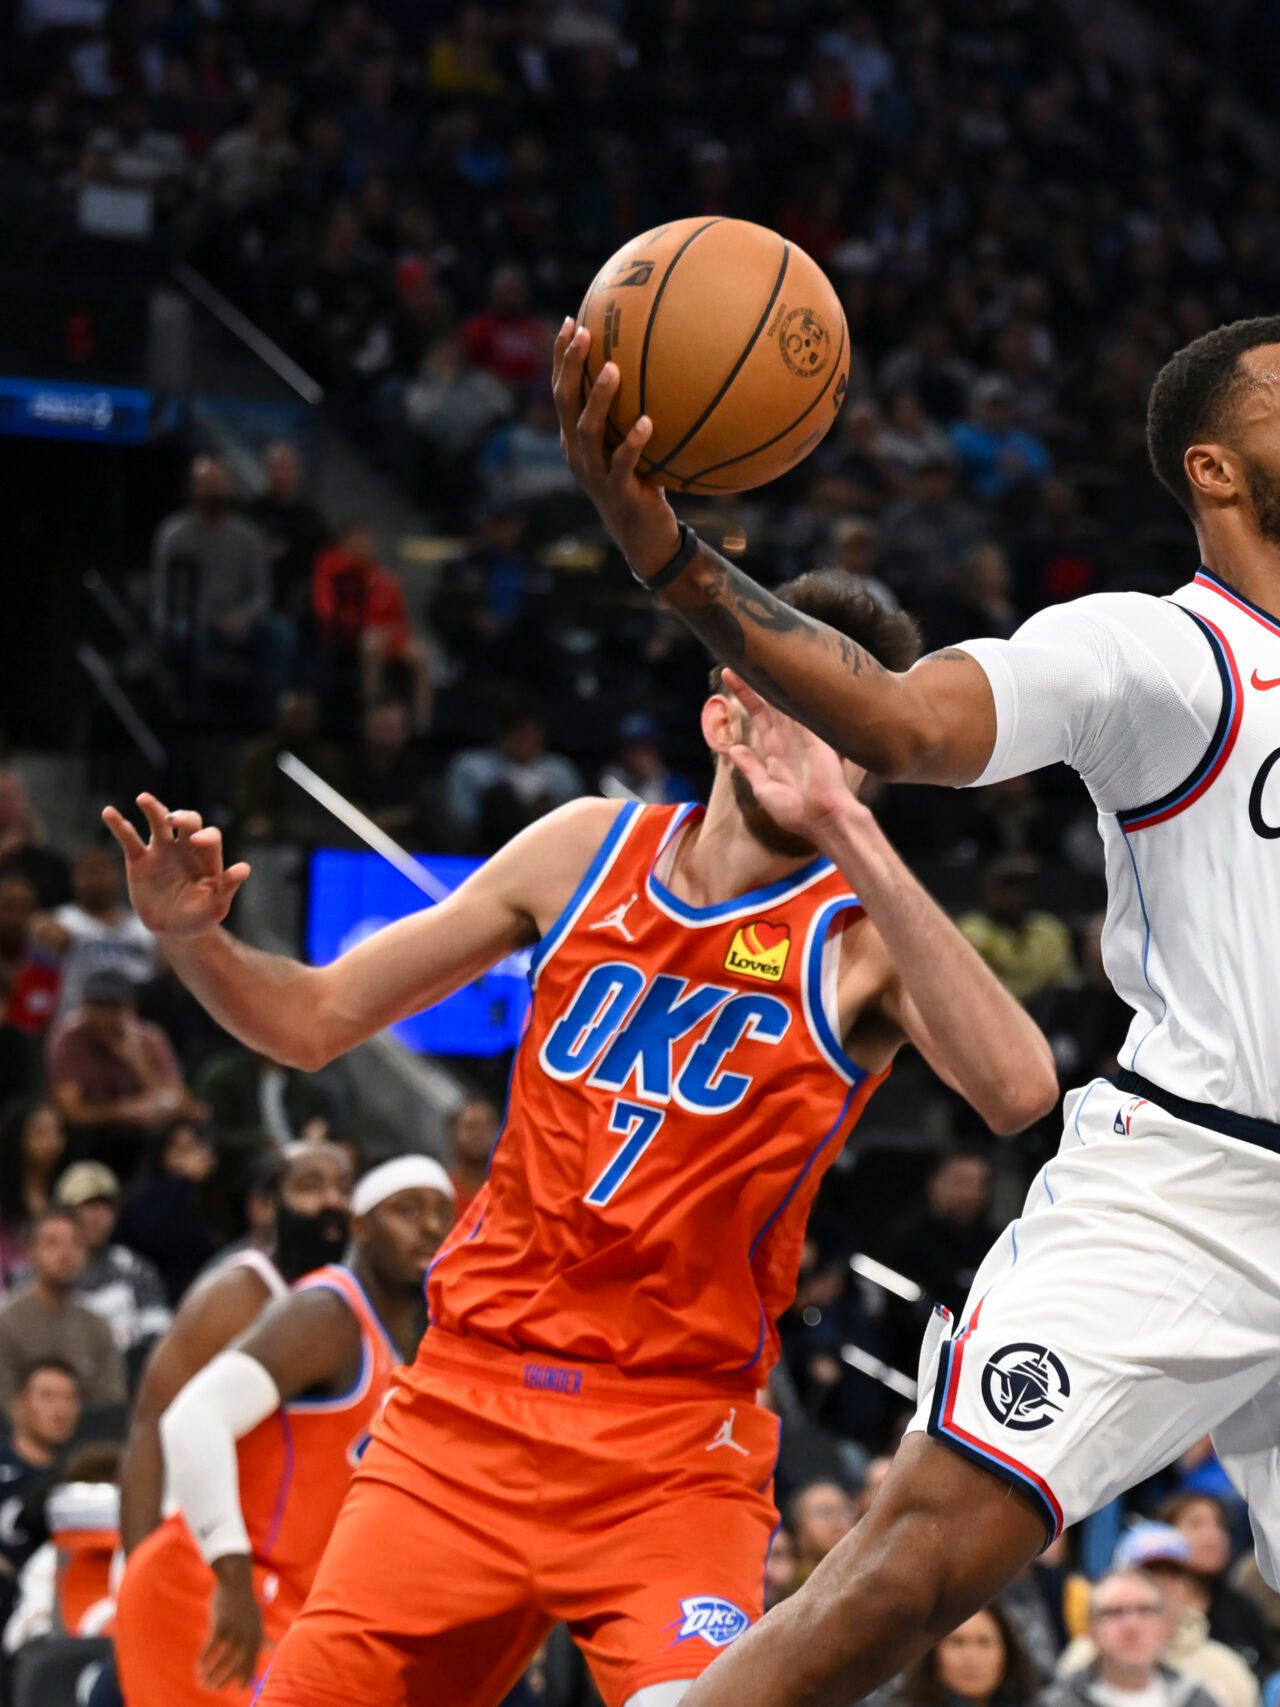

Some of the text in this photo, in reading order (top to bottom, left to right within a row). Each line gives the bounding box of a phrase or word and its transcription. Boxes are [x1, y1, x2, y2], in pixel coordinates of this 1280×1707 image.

[729, 950, 780, 977] Love's
[539, 960, 793, 1116] OKC
[583, 1098, 666, 1207] 7
